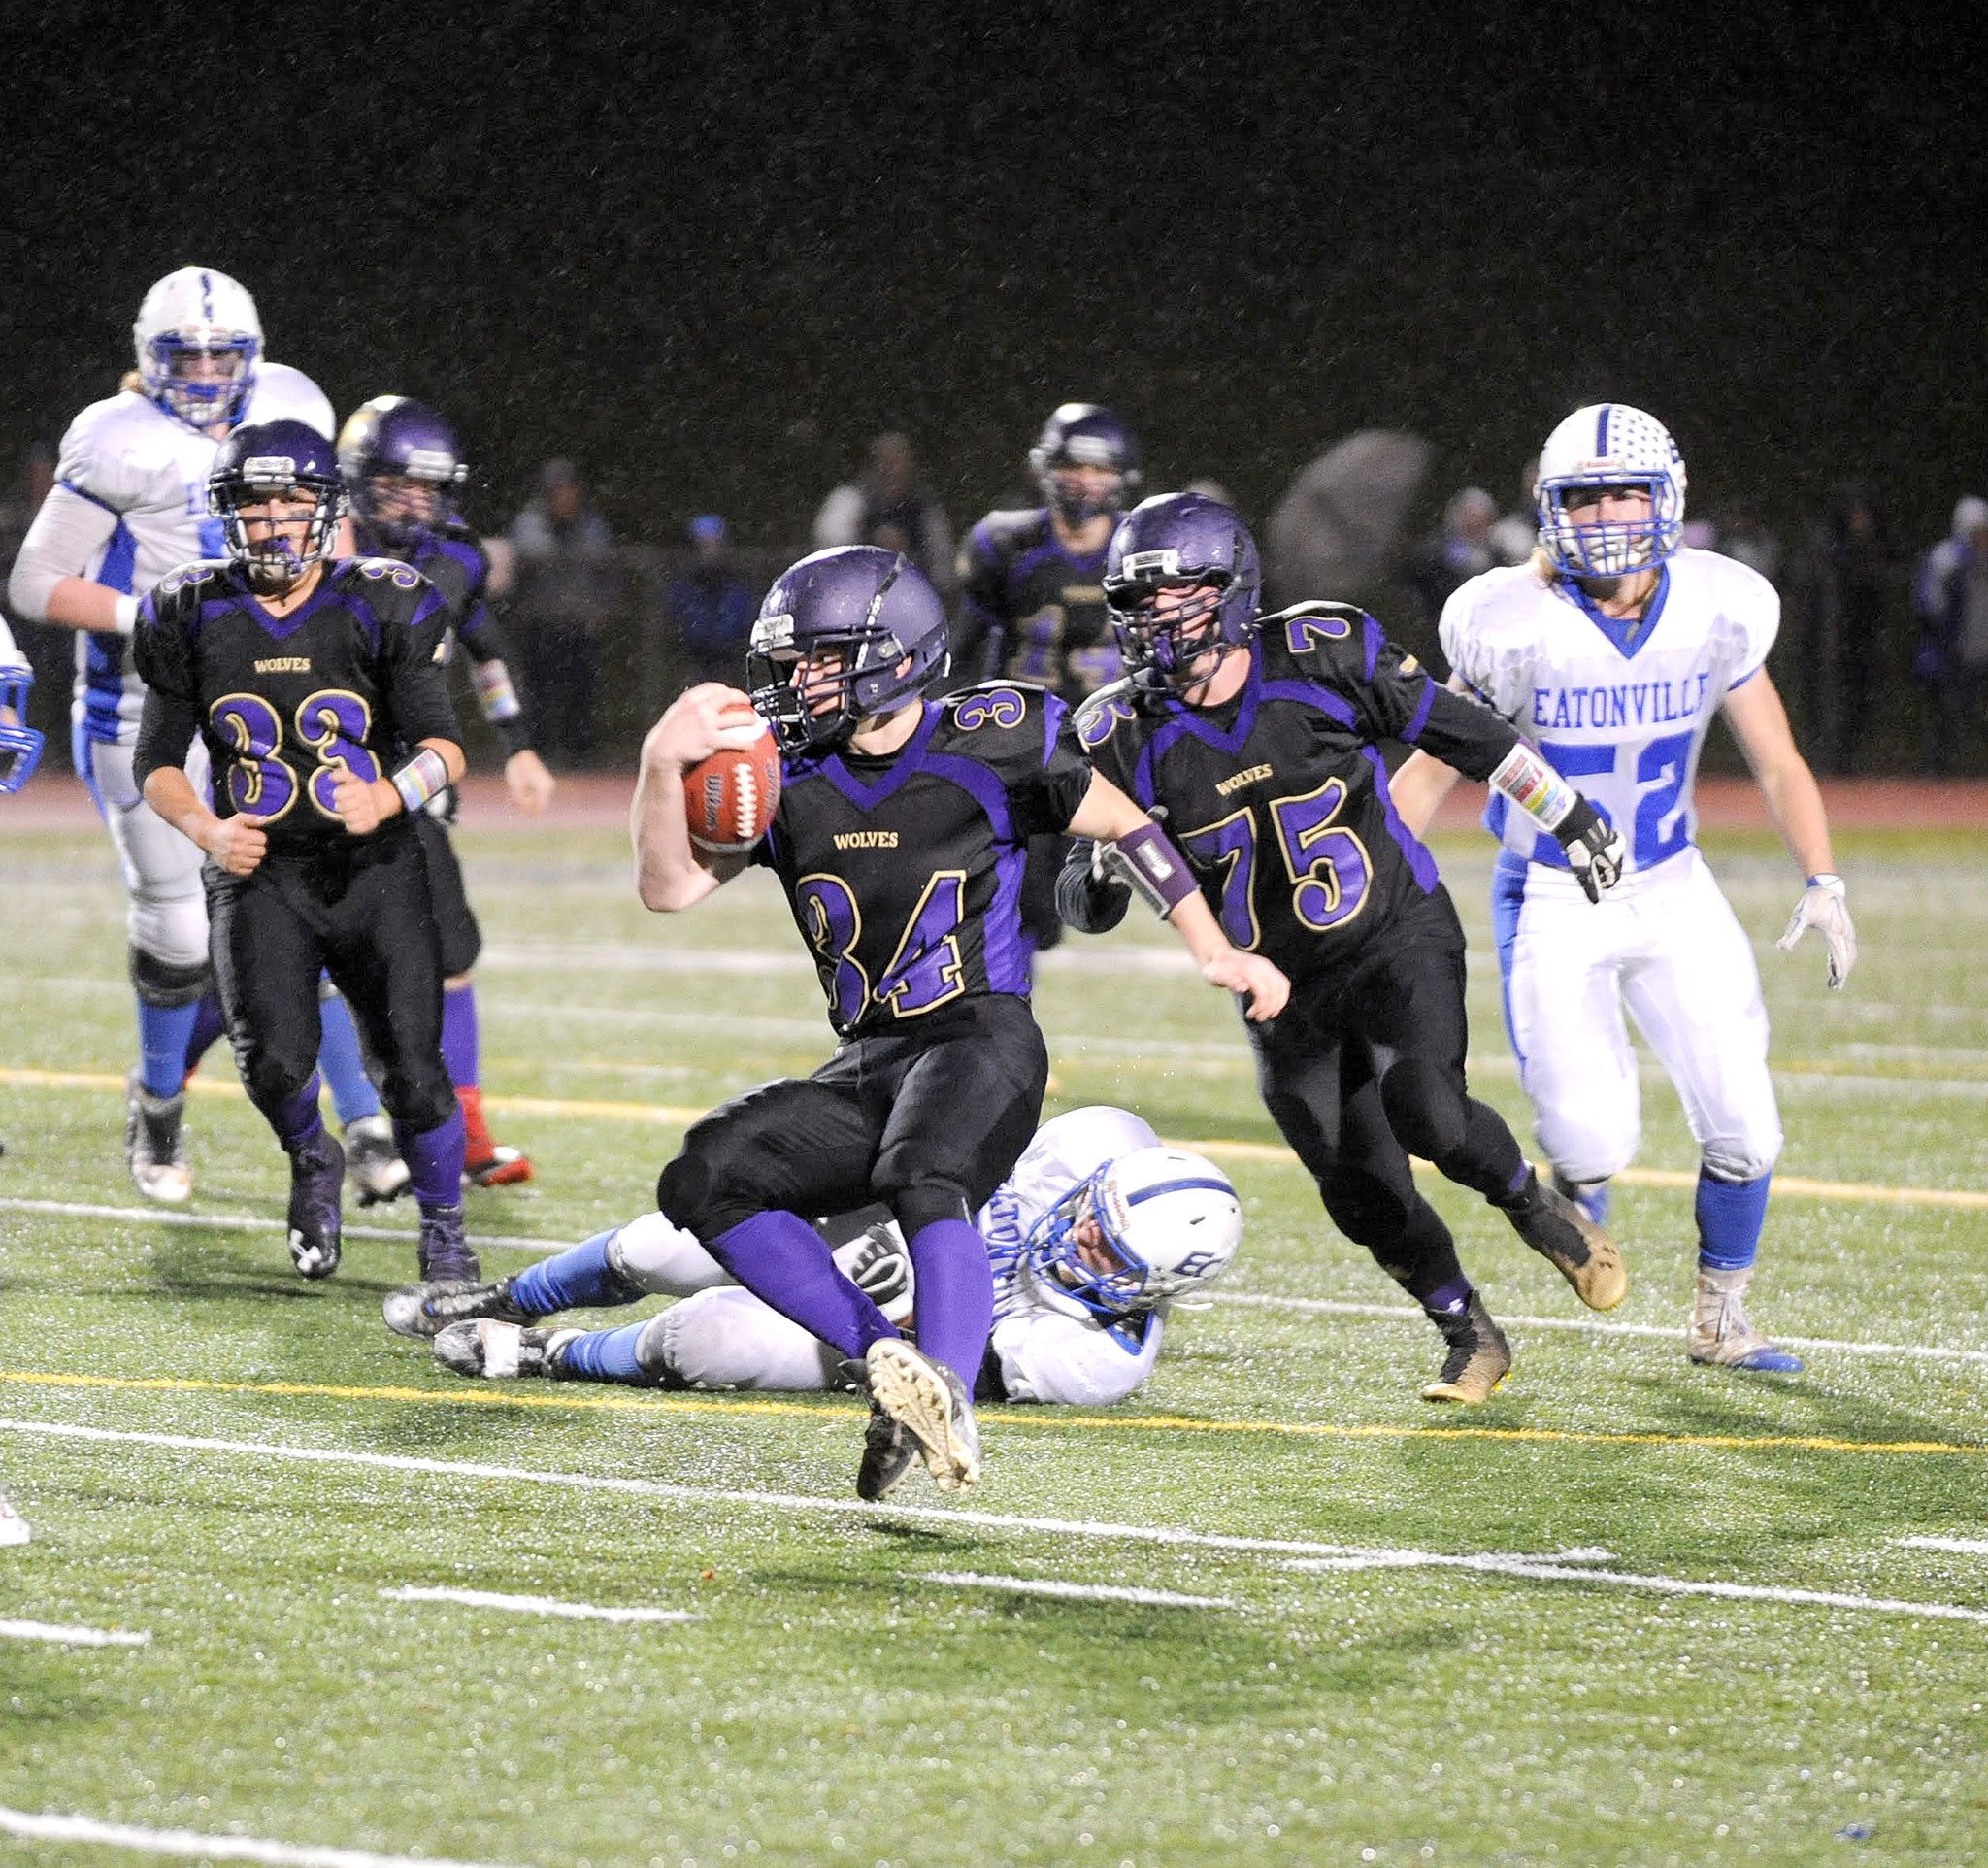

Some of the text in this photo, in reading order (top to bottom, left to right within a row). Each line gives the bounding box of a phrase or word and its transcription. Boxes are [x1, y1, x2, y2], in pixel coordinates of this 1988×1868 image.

[1283, 615, 1352, 654] 7
[253, 656, 312, 674] WOLVES
[953, 687, 1027, 732] 3
[1214, 762, 1275, 797] WOLVES
[833, 830, 900, 851] WOLVES
[1177, 776, 1375, 953] 75
